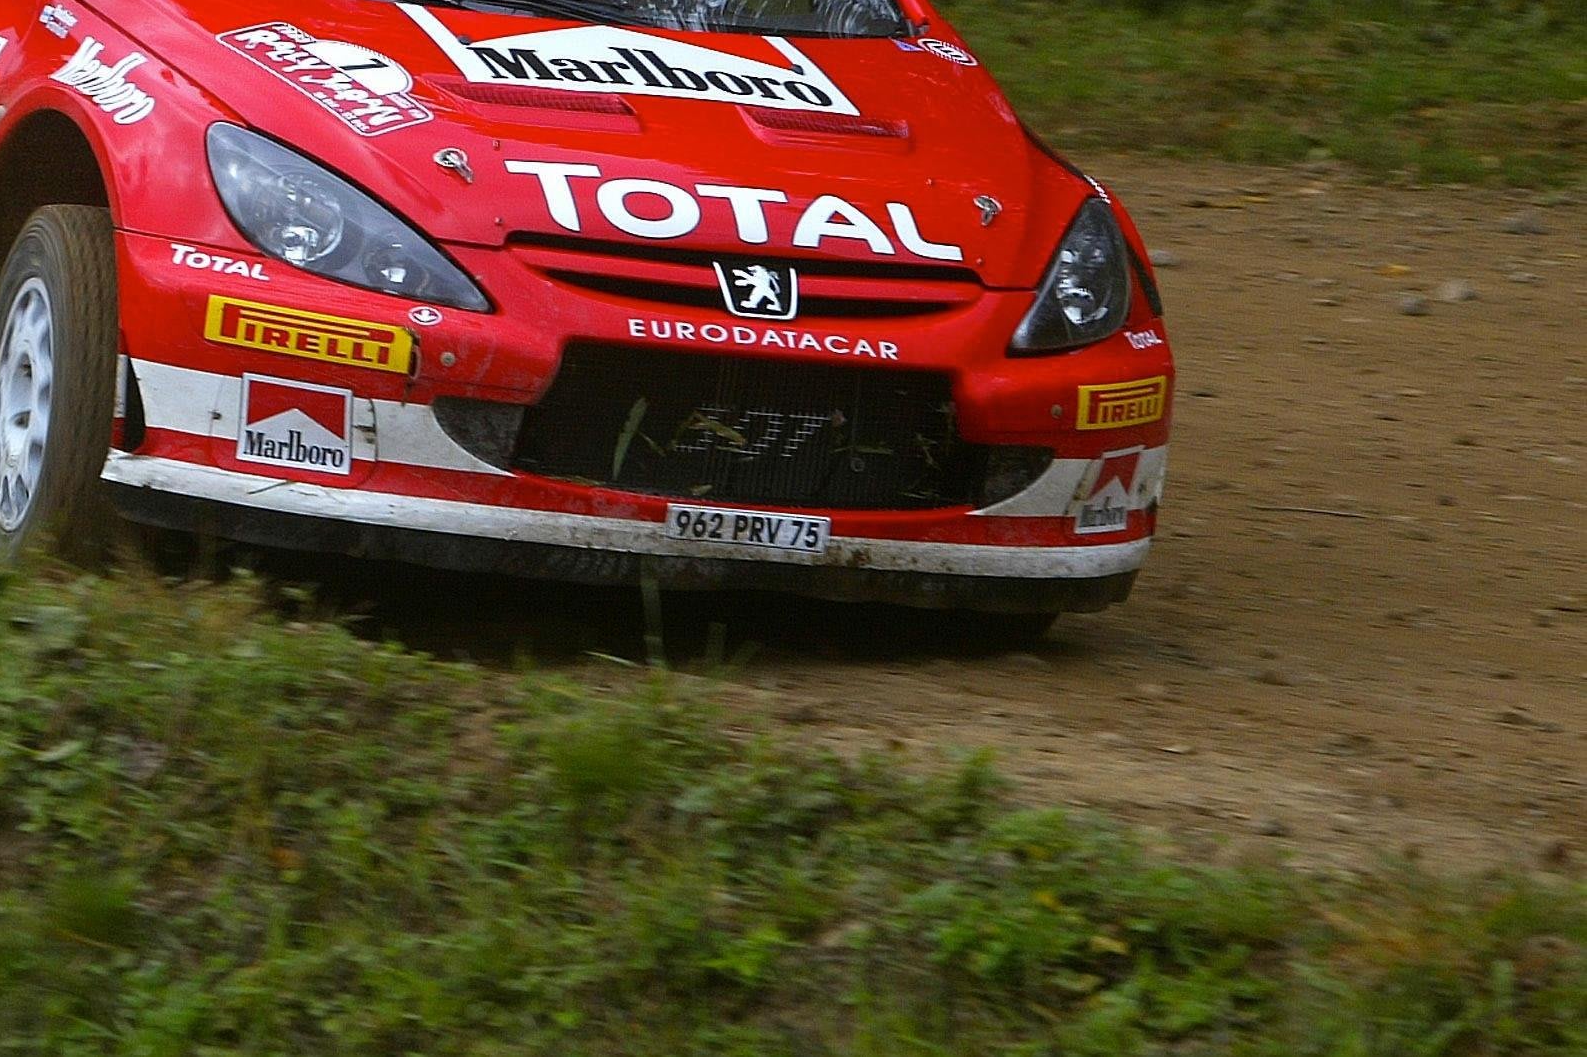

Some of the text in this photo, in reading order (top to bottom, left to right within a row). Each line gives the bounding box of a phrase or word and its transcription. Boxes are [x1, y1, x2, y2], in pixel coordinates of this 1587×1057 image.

[48, 36, 155, 125] Marlboro
[233, 28, 332, 73] RALLY
[298, 71, 404, 127] JAPAN
[467, 45, 835, 108] Marlboro
[506, 160, 963, 262] TOTAL
[170, 244, 270, 282] TOTAL
[221, 303, 395, 366] PIRELLI
[628, 318, 899, 361] EURODATACAR
[1086, 382, 1161, 424] PIRELLI
[243, 429, 345, 469] Marlboro
[676, 511, 820, 548] 962 PRV 75
